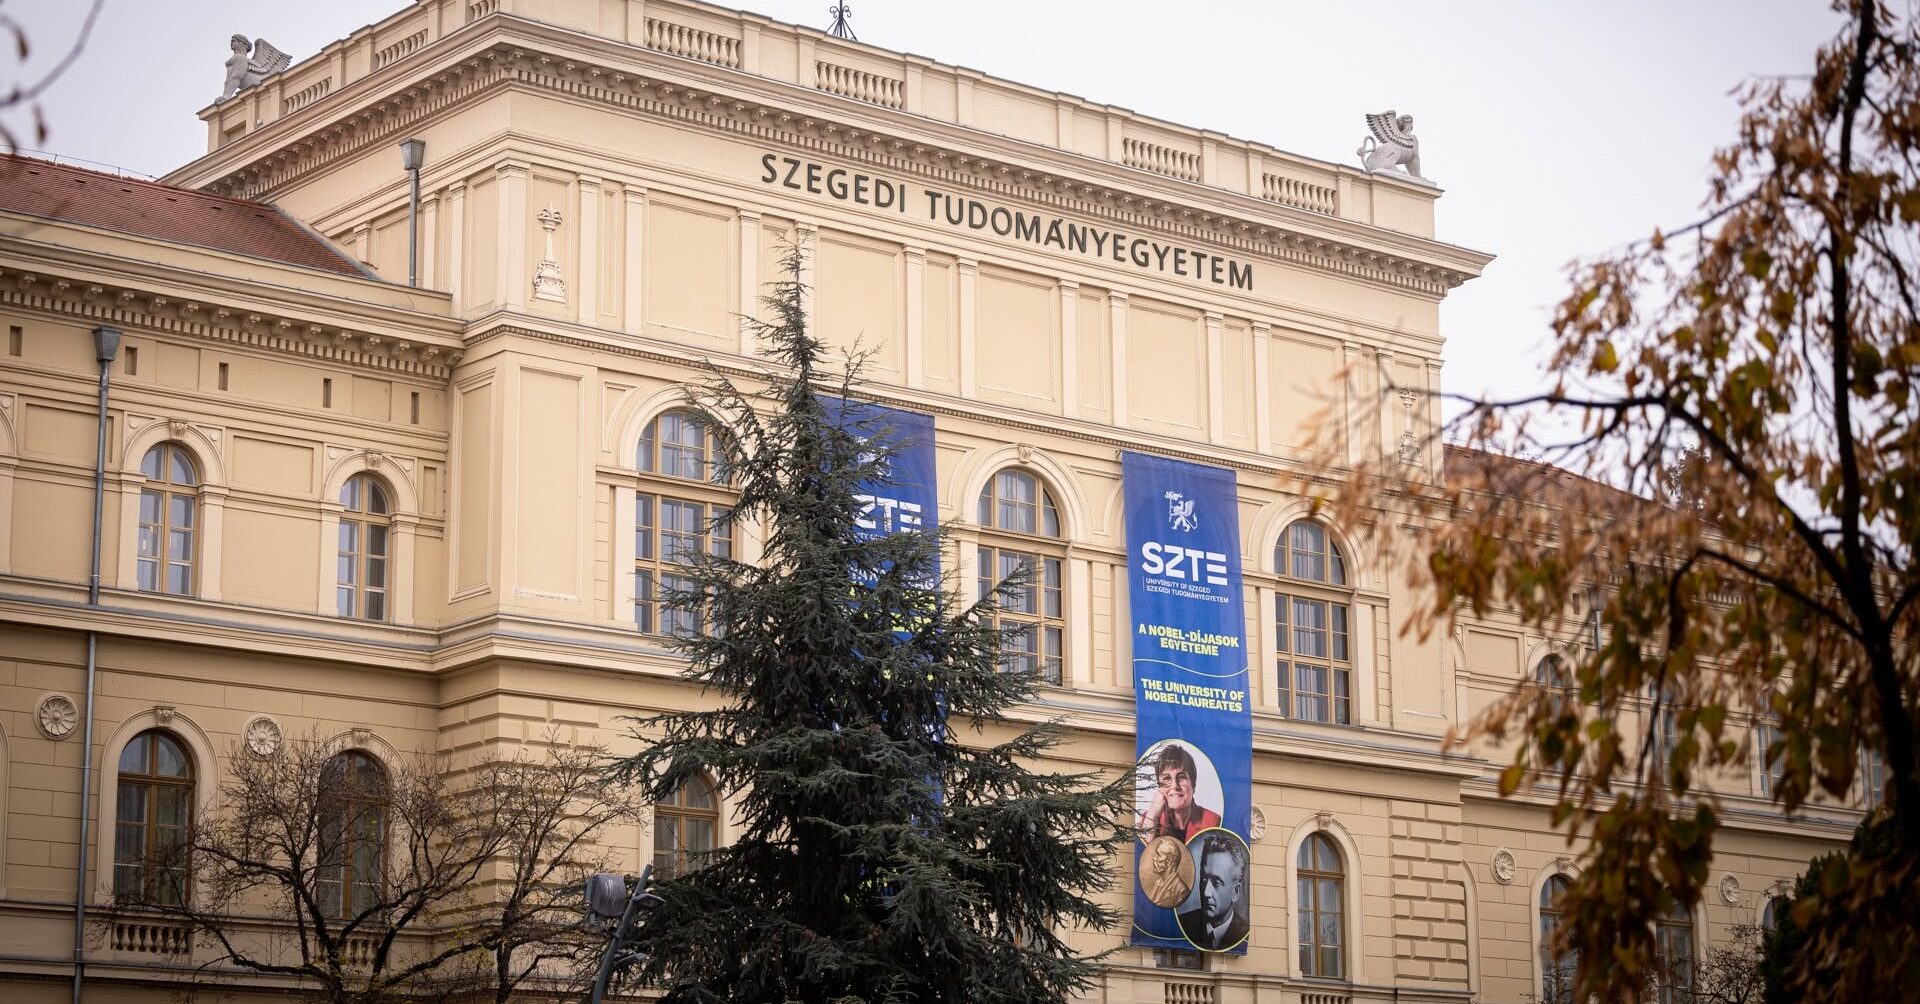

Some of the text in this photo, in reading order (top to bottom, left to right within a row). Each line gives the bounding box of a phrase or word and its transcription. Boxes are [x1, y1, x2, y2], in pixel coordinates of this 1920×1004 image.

[761, 153, 1254, 291] SZEGEDI TUDOMÁNYEGYETEM
[832, 494, 921, 537] ZTE
[1141, 541, 1228, 586] SZTE
[1145, 577, 1179, 588] UNIVERSITY
[1188, 584, 1211, 594] SZEGED
[1146, 585, 1229, 603] SZEGEDI TUDOMÁNYEGYETEM
[1139, 623, 1239, 648] A NOBEL-DÍJASOK
[1160, 637, 1219, 656] EGYETEME
[1141, 678, 1244, 701] THE UNIVERSITY OF
[1144, 690, 1243, 712] NOBEL LAUREATES
